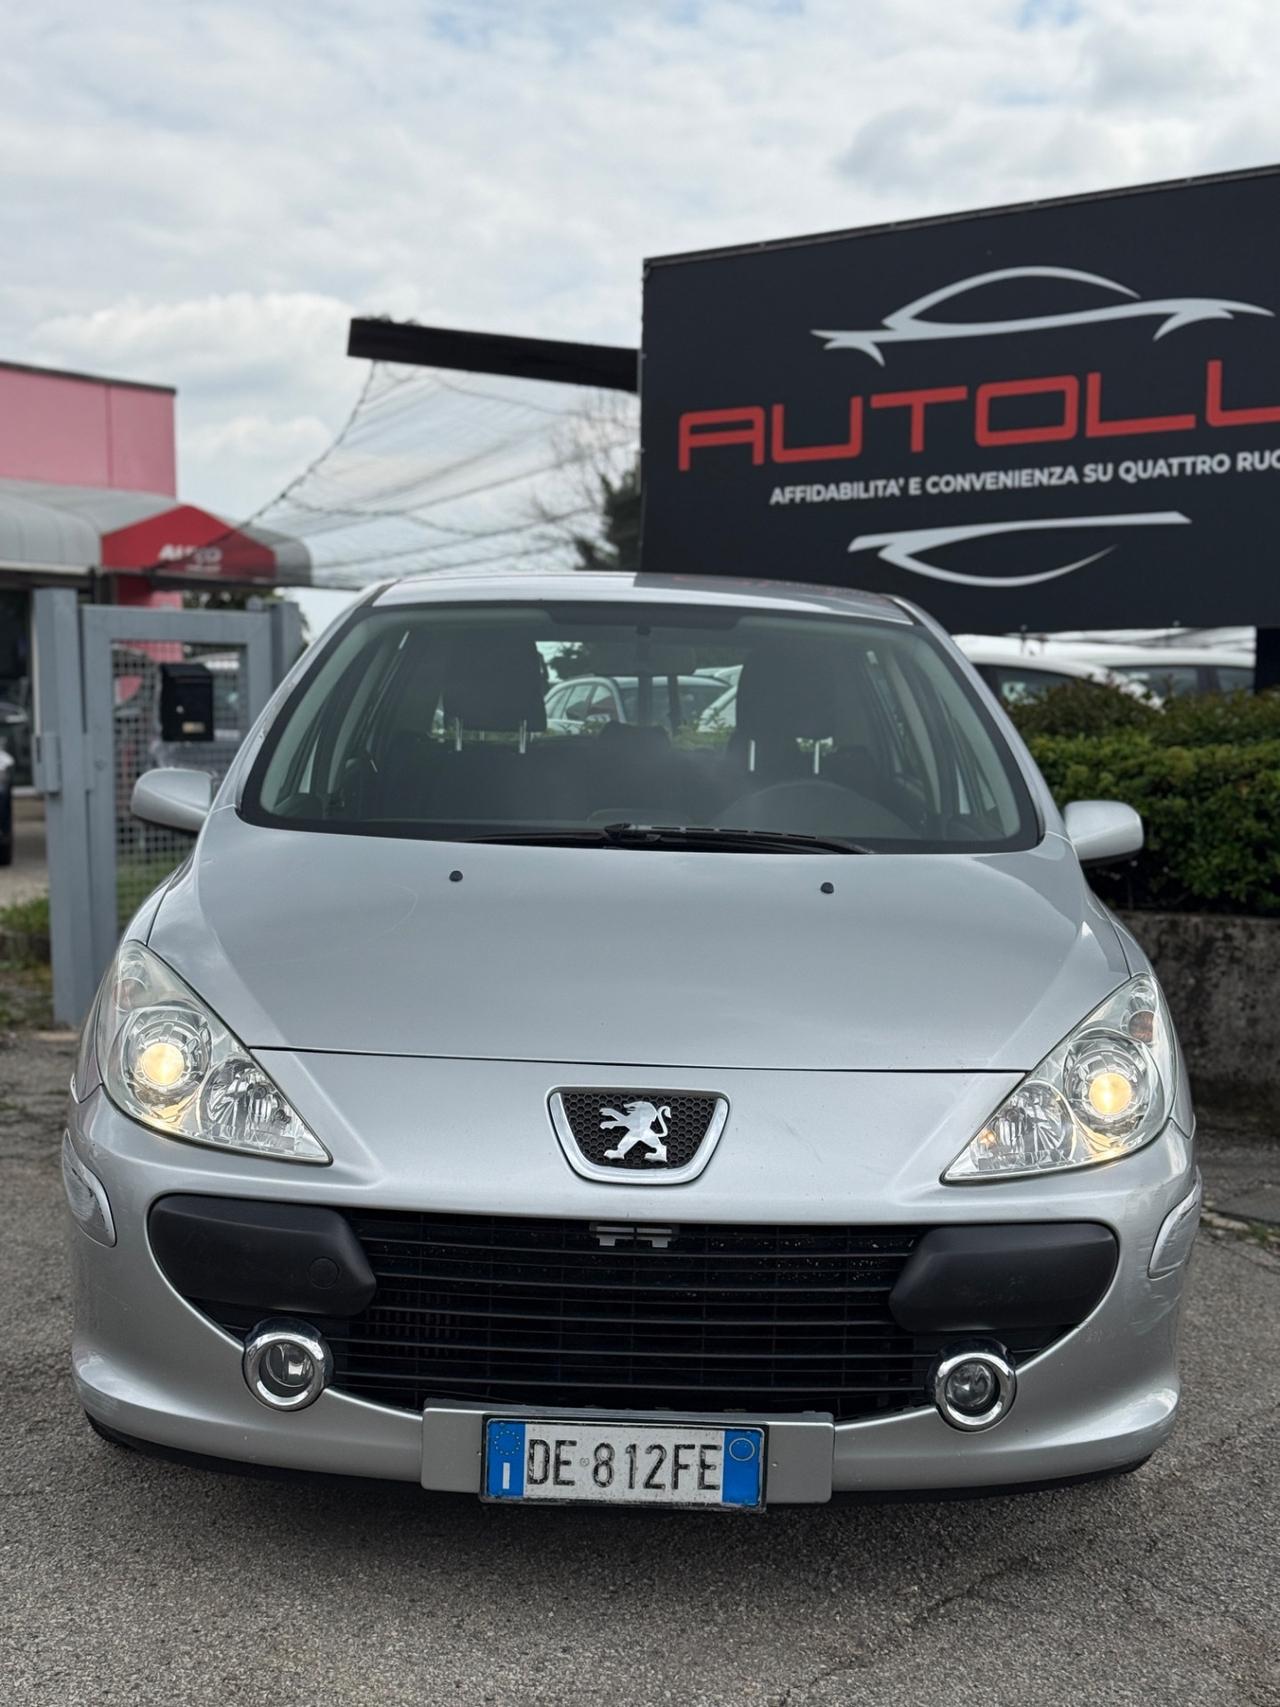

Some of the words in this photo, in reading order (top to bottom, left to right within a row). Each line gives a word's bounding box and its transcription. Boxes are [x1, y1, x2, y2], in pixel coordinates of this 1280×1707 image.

[769, 477, 904, 505] AFFIDABILITA'
[908, 477, 922, 495] E
[925, 465, 1079, 494] CONVENIENZA
[1083, 462, 1114, 483] SU
[1118, 453, 1231, 484] QUATTRO
[502, 1462, 511, 1489] I
[526, 1439, 577, 1486] DE
